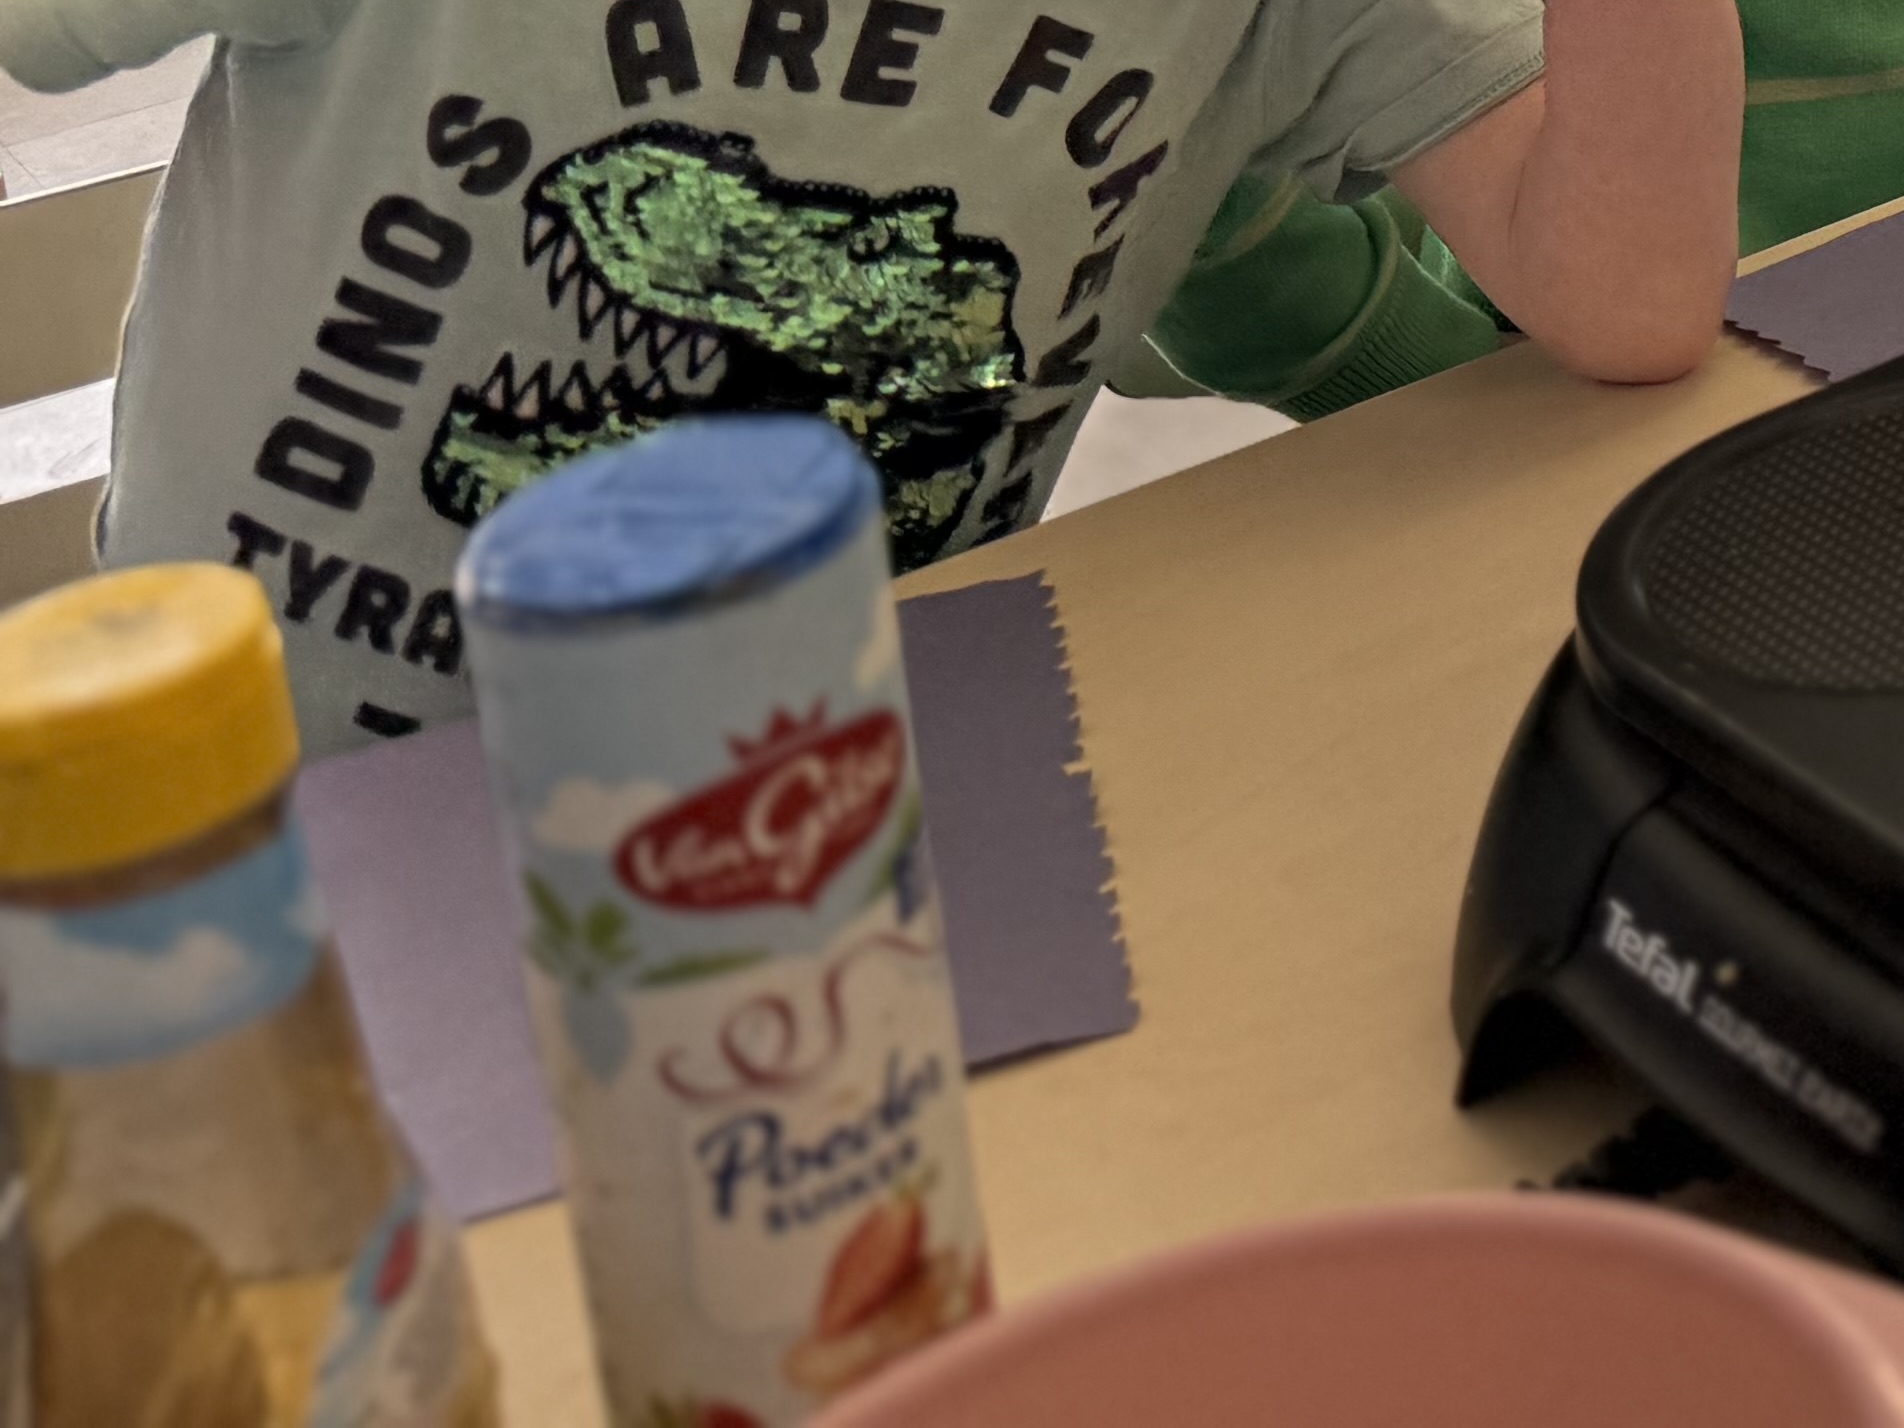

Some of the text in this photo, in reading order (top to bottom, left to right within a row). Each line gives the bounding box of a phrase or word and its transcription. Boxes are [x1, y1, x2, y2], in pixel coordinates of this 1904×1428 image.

[255, 92, 532, 511] DINOS
[227, 511, 463, 676] TYRA
[1603, 899, 1698, 1015] Tefal
